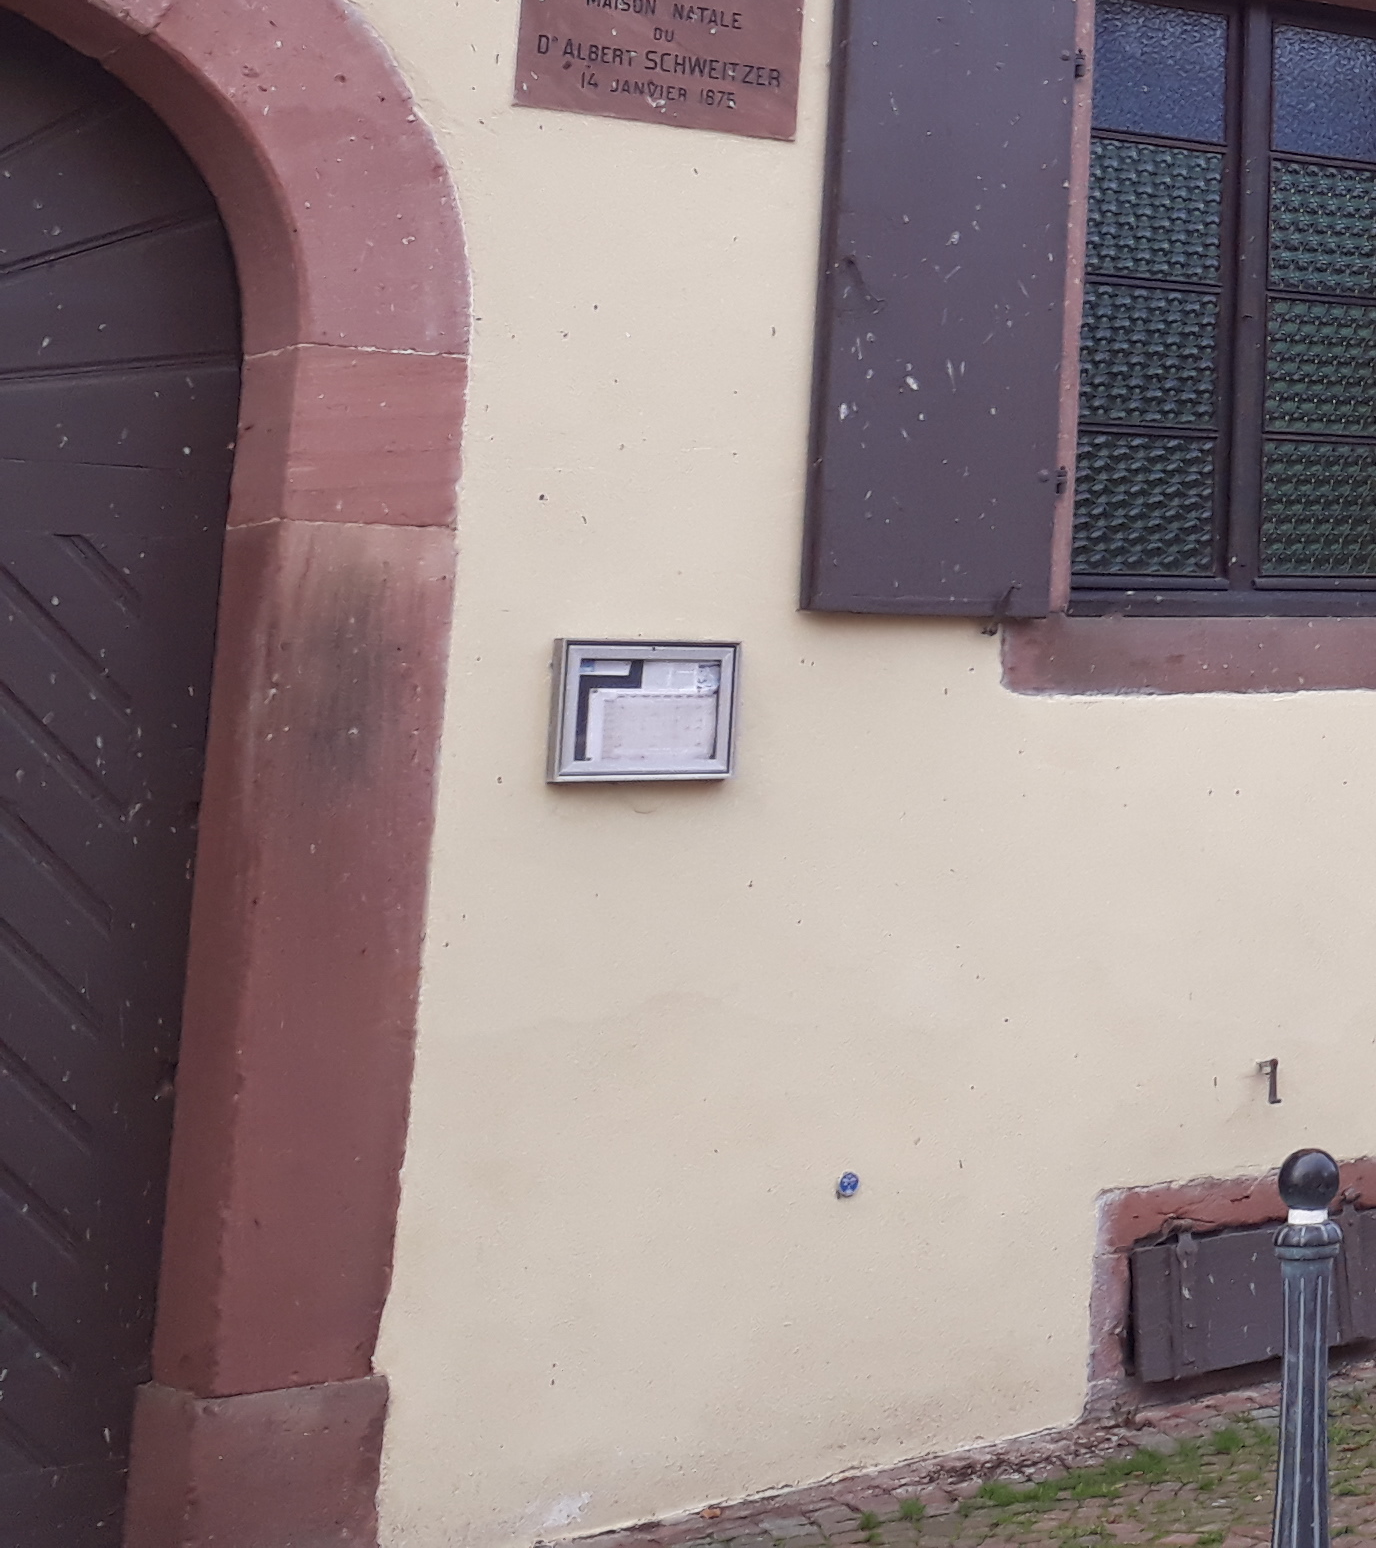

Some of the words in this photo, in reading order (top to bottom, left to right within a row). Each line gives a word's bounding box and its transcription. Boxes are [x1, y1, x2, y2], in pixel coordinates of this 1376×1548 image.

[673, 3, 743, 30] NATALE
[654, 27, 675, 43] DU
[562, 38, 638, 67] ALBERT
[644, 50, 781, 88] SCHWEITZER
[581, 71, 599, 89] 14
[609, 78, 688, 101] JANVIER
[700, 88, 736, 109] 1875
